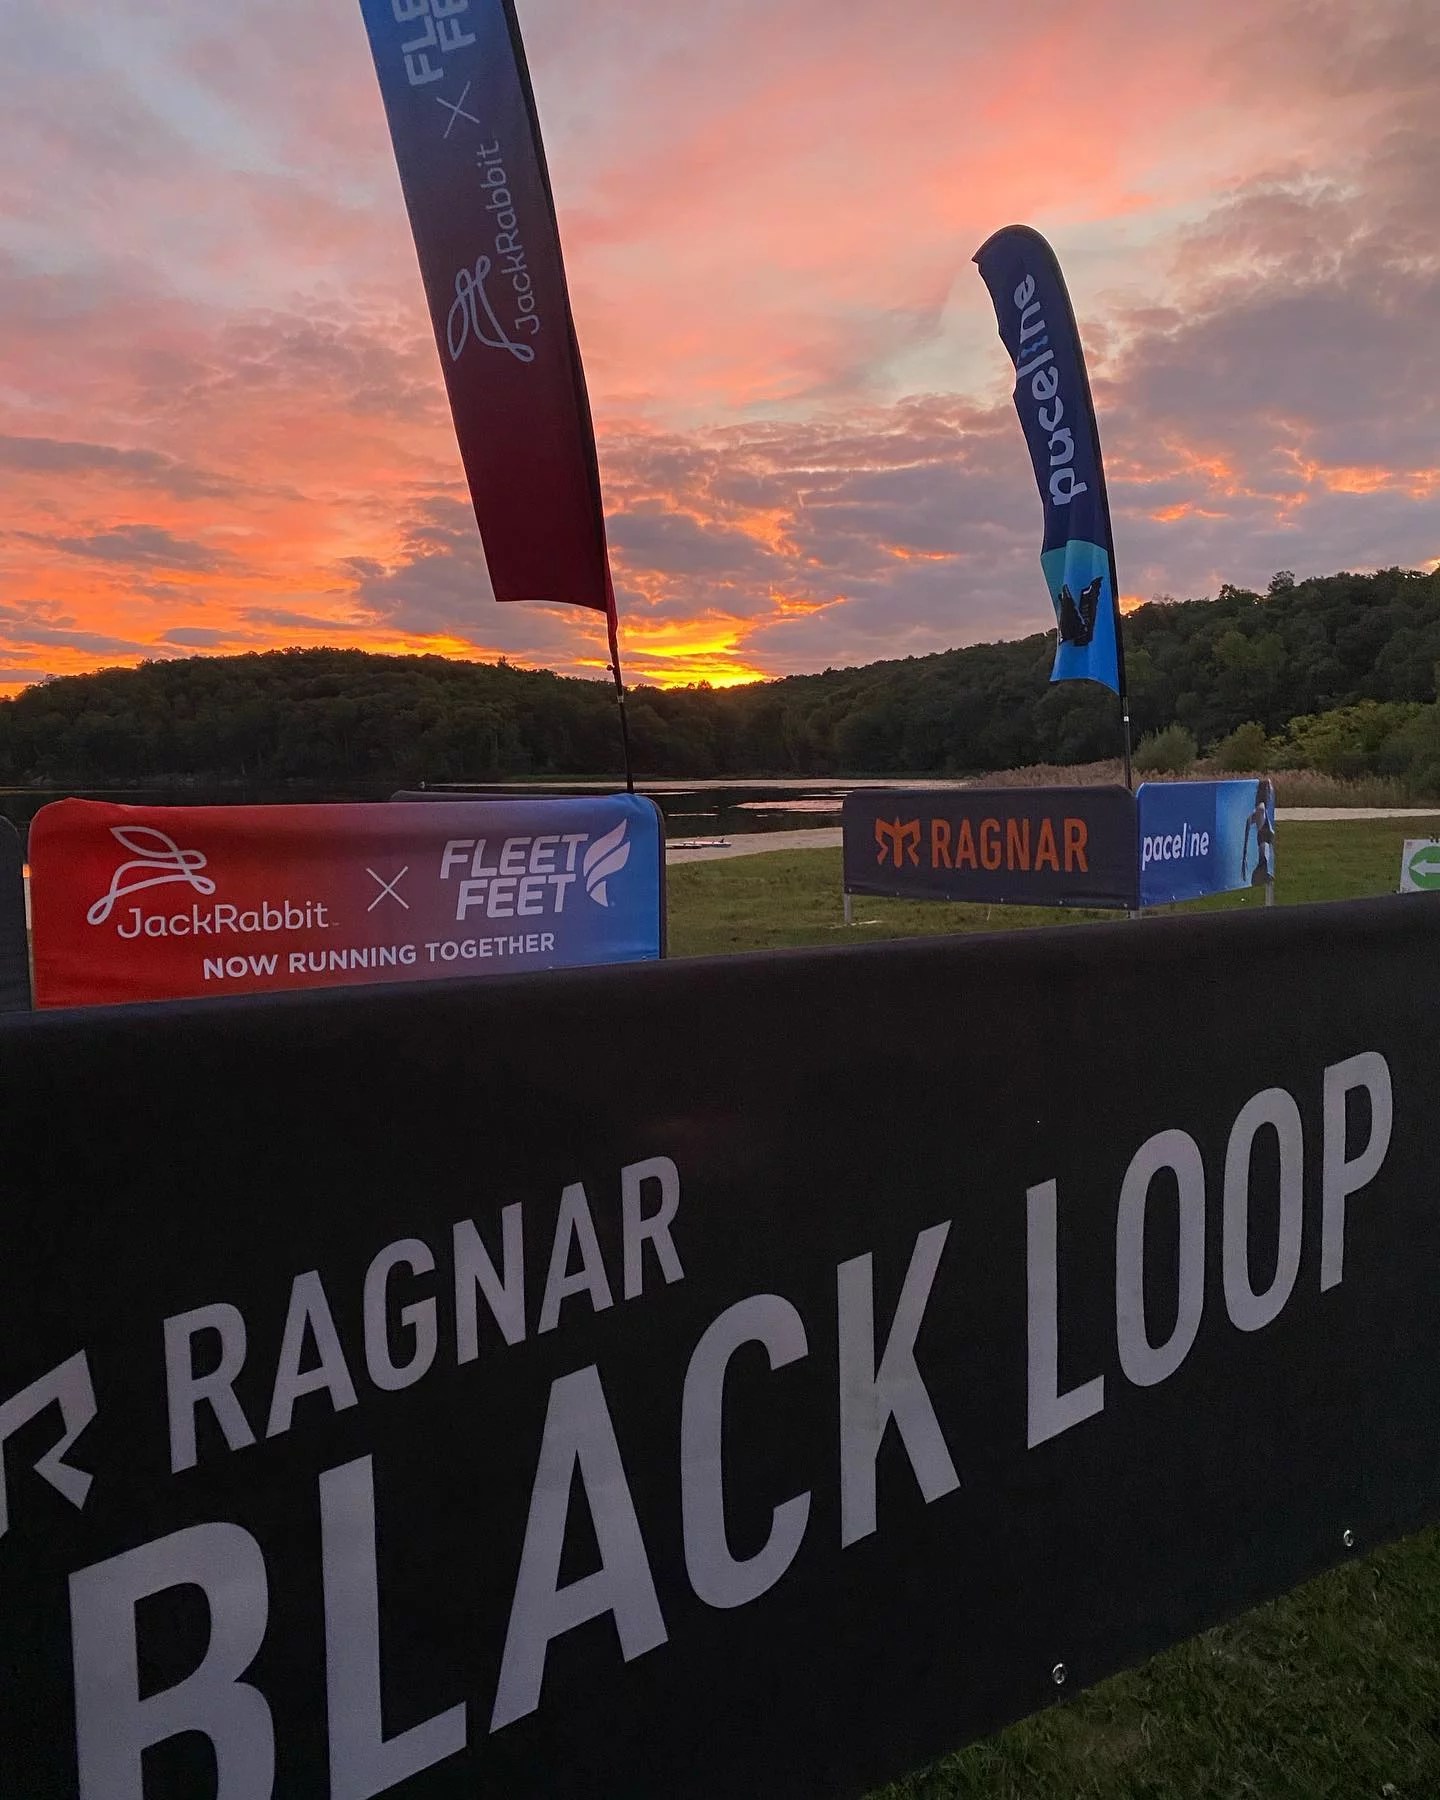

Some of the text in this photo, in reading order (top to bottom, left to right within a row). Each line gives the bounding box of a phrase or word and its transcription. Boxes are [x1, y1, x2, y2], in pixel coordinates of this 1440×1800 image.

[476, 140, 540, 335] JackRabbit
[1013, 273, 1088, 506] paceline
[440, 833, 589, 879] FLEET
[931, 817, 1089, 873] RAGNAR
[1141, 822, 1210, 871] paceline
[117, 900, 329, 938] JackRabbit
[456, 873, 576, 920] FEET
[203, 933, 555, 980] NOW RUNNING TOGETHER
[163, 1156, 686, 1475] RAGNAR
[68, 1051, 1393, 1800] BLACK LOOP
